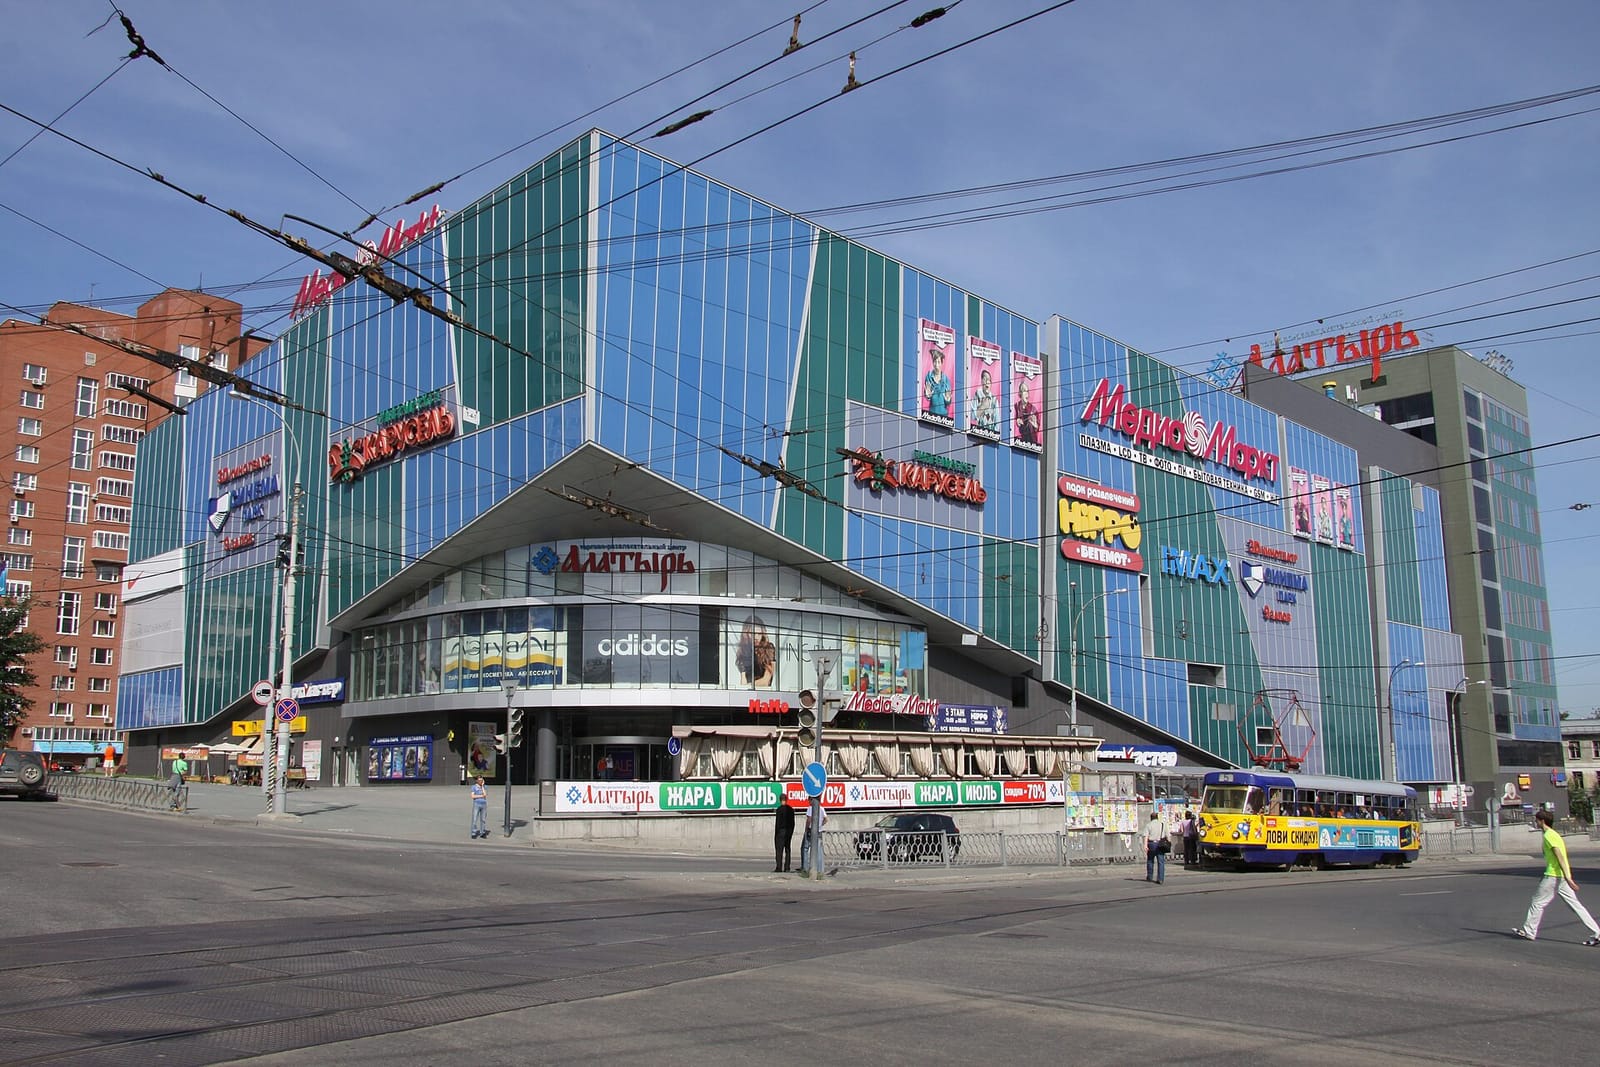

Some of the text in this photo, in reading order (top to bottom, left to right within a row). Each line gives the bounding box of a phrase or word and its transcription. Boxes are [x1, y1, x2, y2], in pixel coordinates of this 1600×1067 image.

[362, 405, 455, 461] КАРУСЕЛЬ
[1081, 377, 1279, 482] Медиа Маркт
[914, 449, 977, 475] ГИПЕРМАРКЕТ
[1080, 434, 1111, 453] ПЛАЗМА
[1118, 446, 1132, 459] LCD
[1139, 452, 1147, 464] ТВ
[1154, 457, 1172, 472] ФОТО
[1177, 464, 1187, 475] ПК
[1193, 469, 1223, 487] БЫТОВАЯ
[1223, 479, 1248, 493] ТЕХНИКА
[1254, 488, 1265, 499] GSM
[217, 467, 230, 484] 3D
[899, 463, 987, 502] КАРУСЕЛЬ
[230, 474, 280, 508] СИНЕМА
[1066, 481, 1135, 508] парк развлечений
[1248, 539, 1260, 553] 3D
[1161, 545, 1231, 586] IMAX
[598, 633, 689, 656] adidas
[846, 691, 939, 716] Media Markt
[667, 786, 715, 807] ЖАРА
[733, 786, 777, 806] ИЮЛЬ
[920, 785, 954, 803] ЖАРА
[965, 785, 997, 802] ИЮЛЬ
[1266, 830, 1318, 846] ЛОВИ СКИДКУ!
